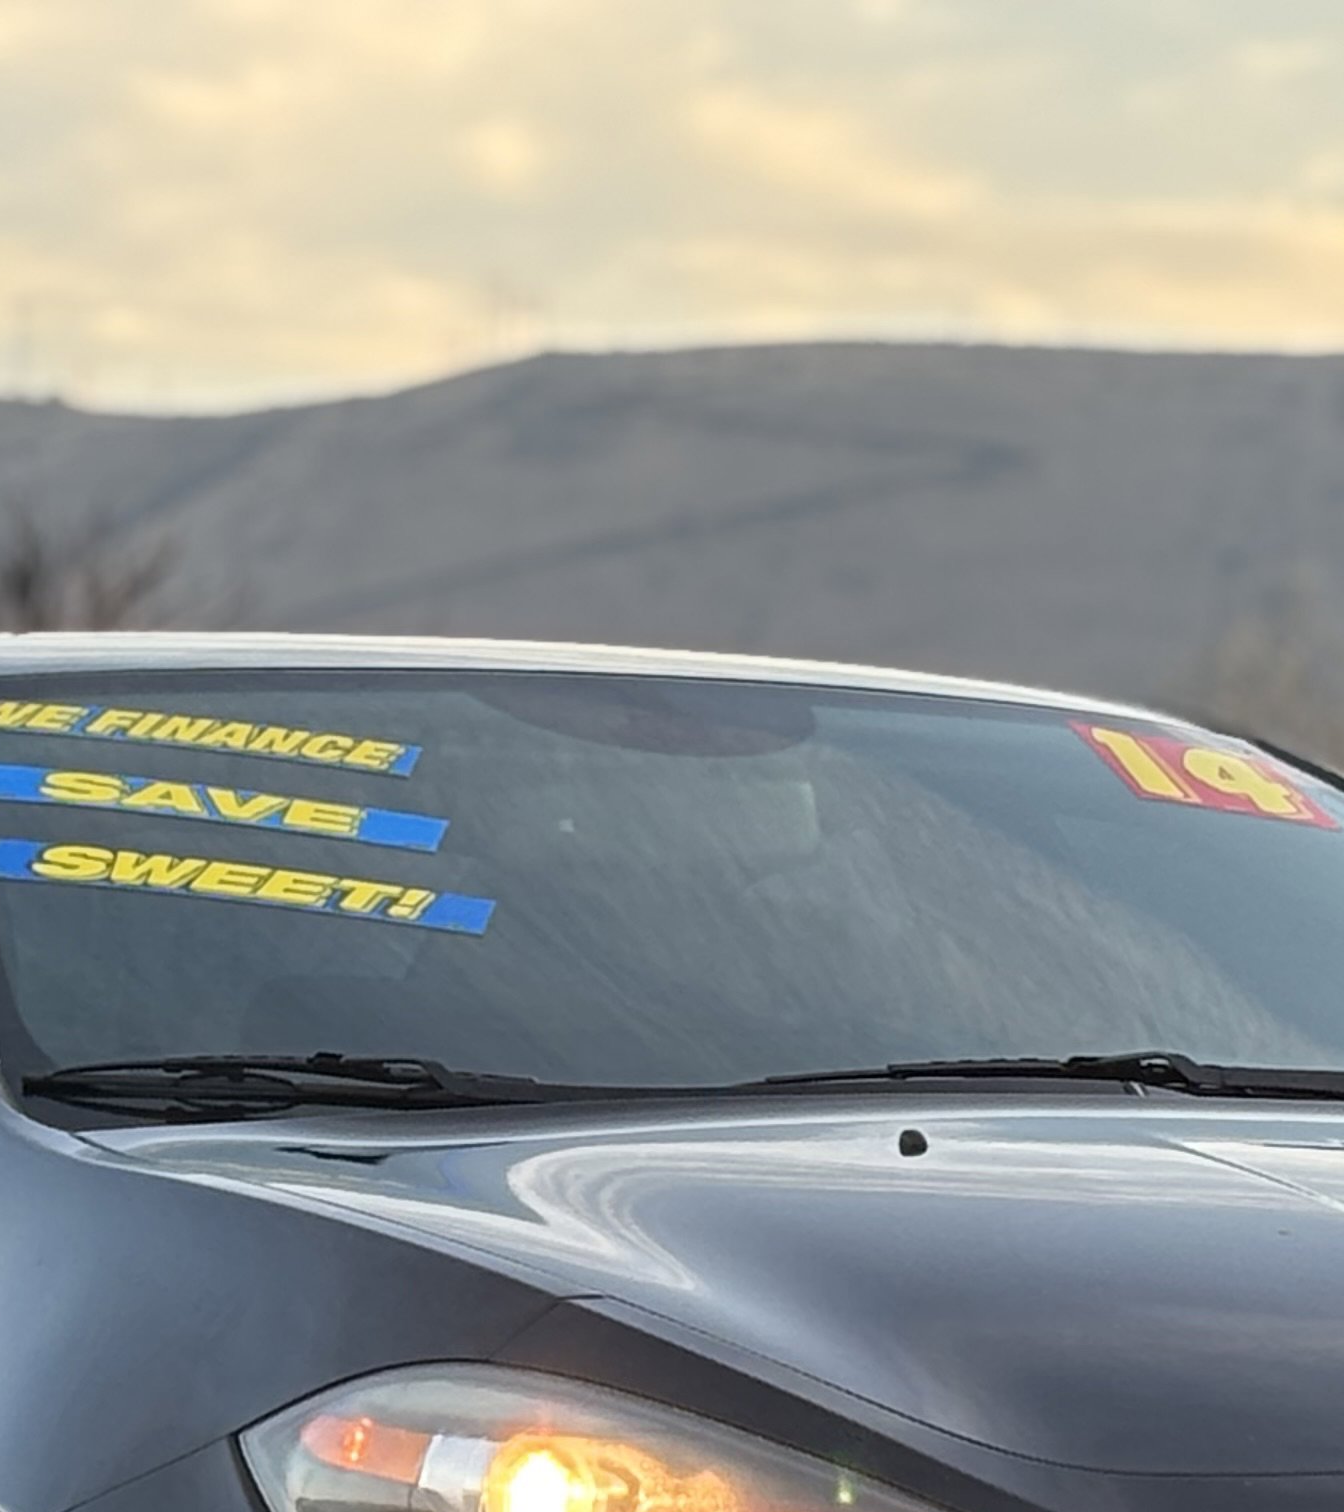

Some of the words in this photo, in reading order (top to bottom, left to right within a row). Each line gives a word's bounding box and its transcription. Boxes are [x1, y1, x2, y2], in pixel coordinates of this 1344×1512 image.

[86, 708, 406, 770] FINANCE
[1089, 726, 1314, 819] 14
[39, 771, 365, 834] SAVE
[32, 844, 436, 920] SWEET!
